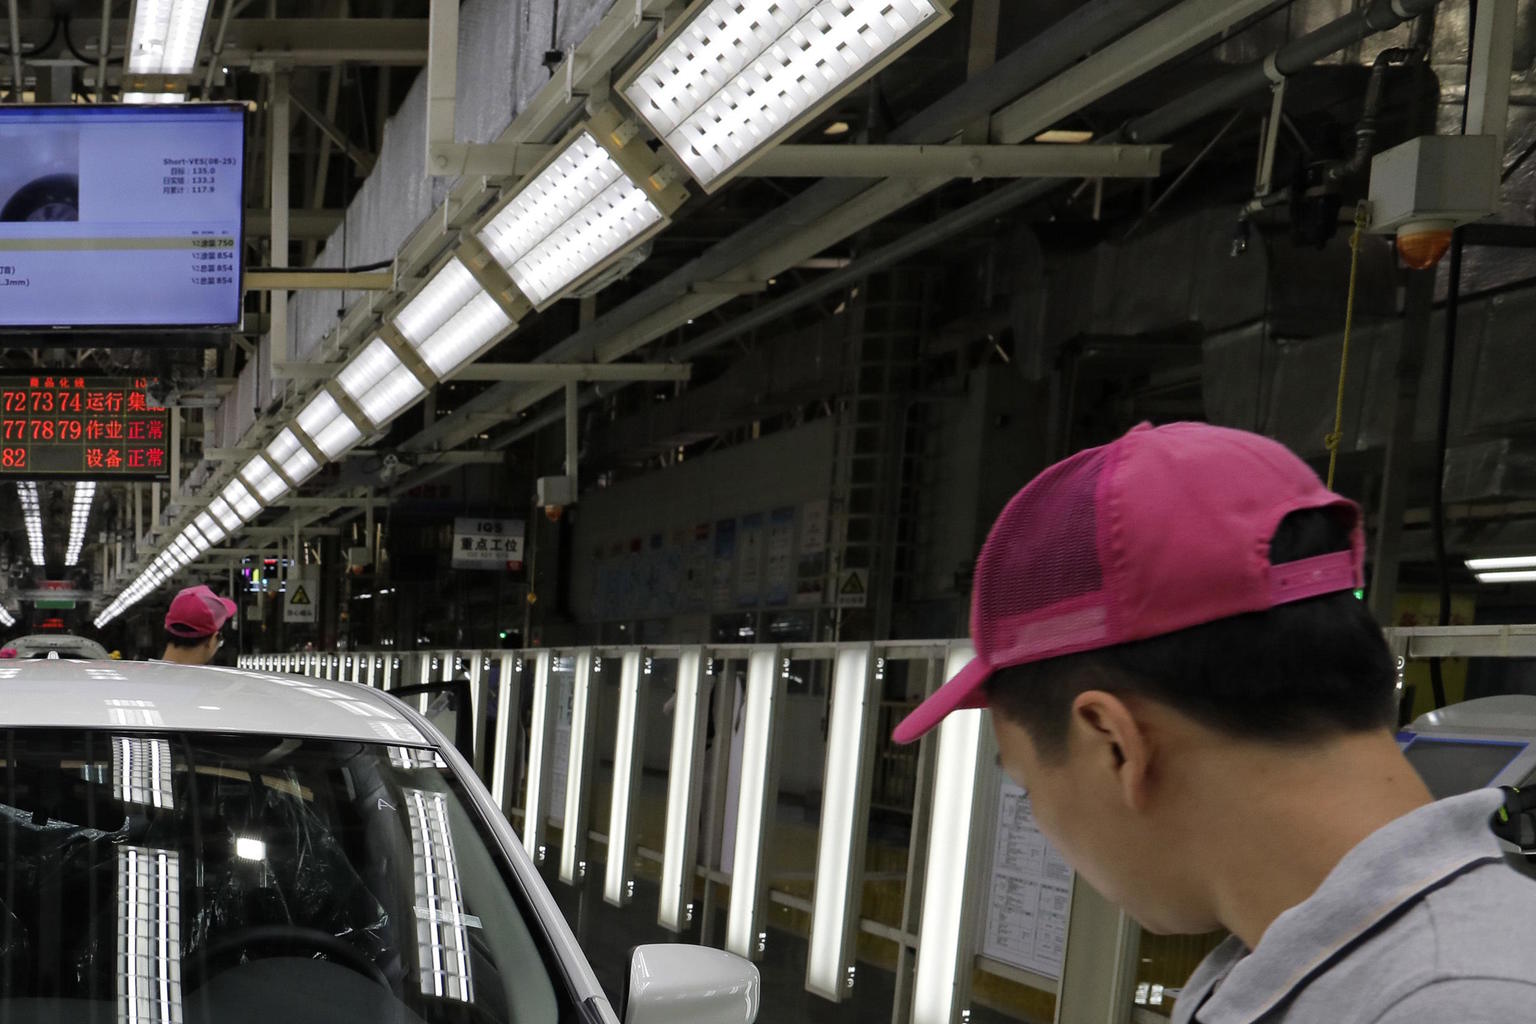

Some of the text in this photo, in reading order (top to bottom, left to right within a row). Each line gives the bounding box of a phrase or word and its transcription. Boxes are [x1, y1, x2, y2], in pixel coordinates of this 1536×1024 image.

[3, 391, 27, 412] 72
[30, 391, 54, 412] 73
[58, 391, 82, 412] 74
[85, 391, 122, 412] 运行
[3, 420, 26, 440] 77
[30, 420, 54, 440] 78
[58, 420, 82, 440] 79
[85, 420, 124, 440] 作业
[128, 421, 164, 440] 正常
[2, 448, 26, 467] 82
[85, 448, 123, 468] 设备
[127, 448, 164, 468] 正常
[461, 537, 518, 553] 重点工位
